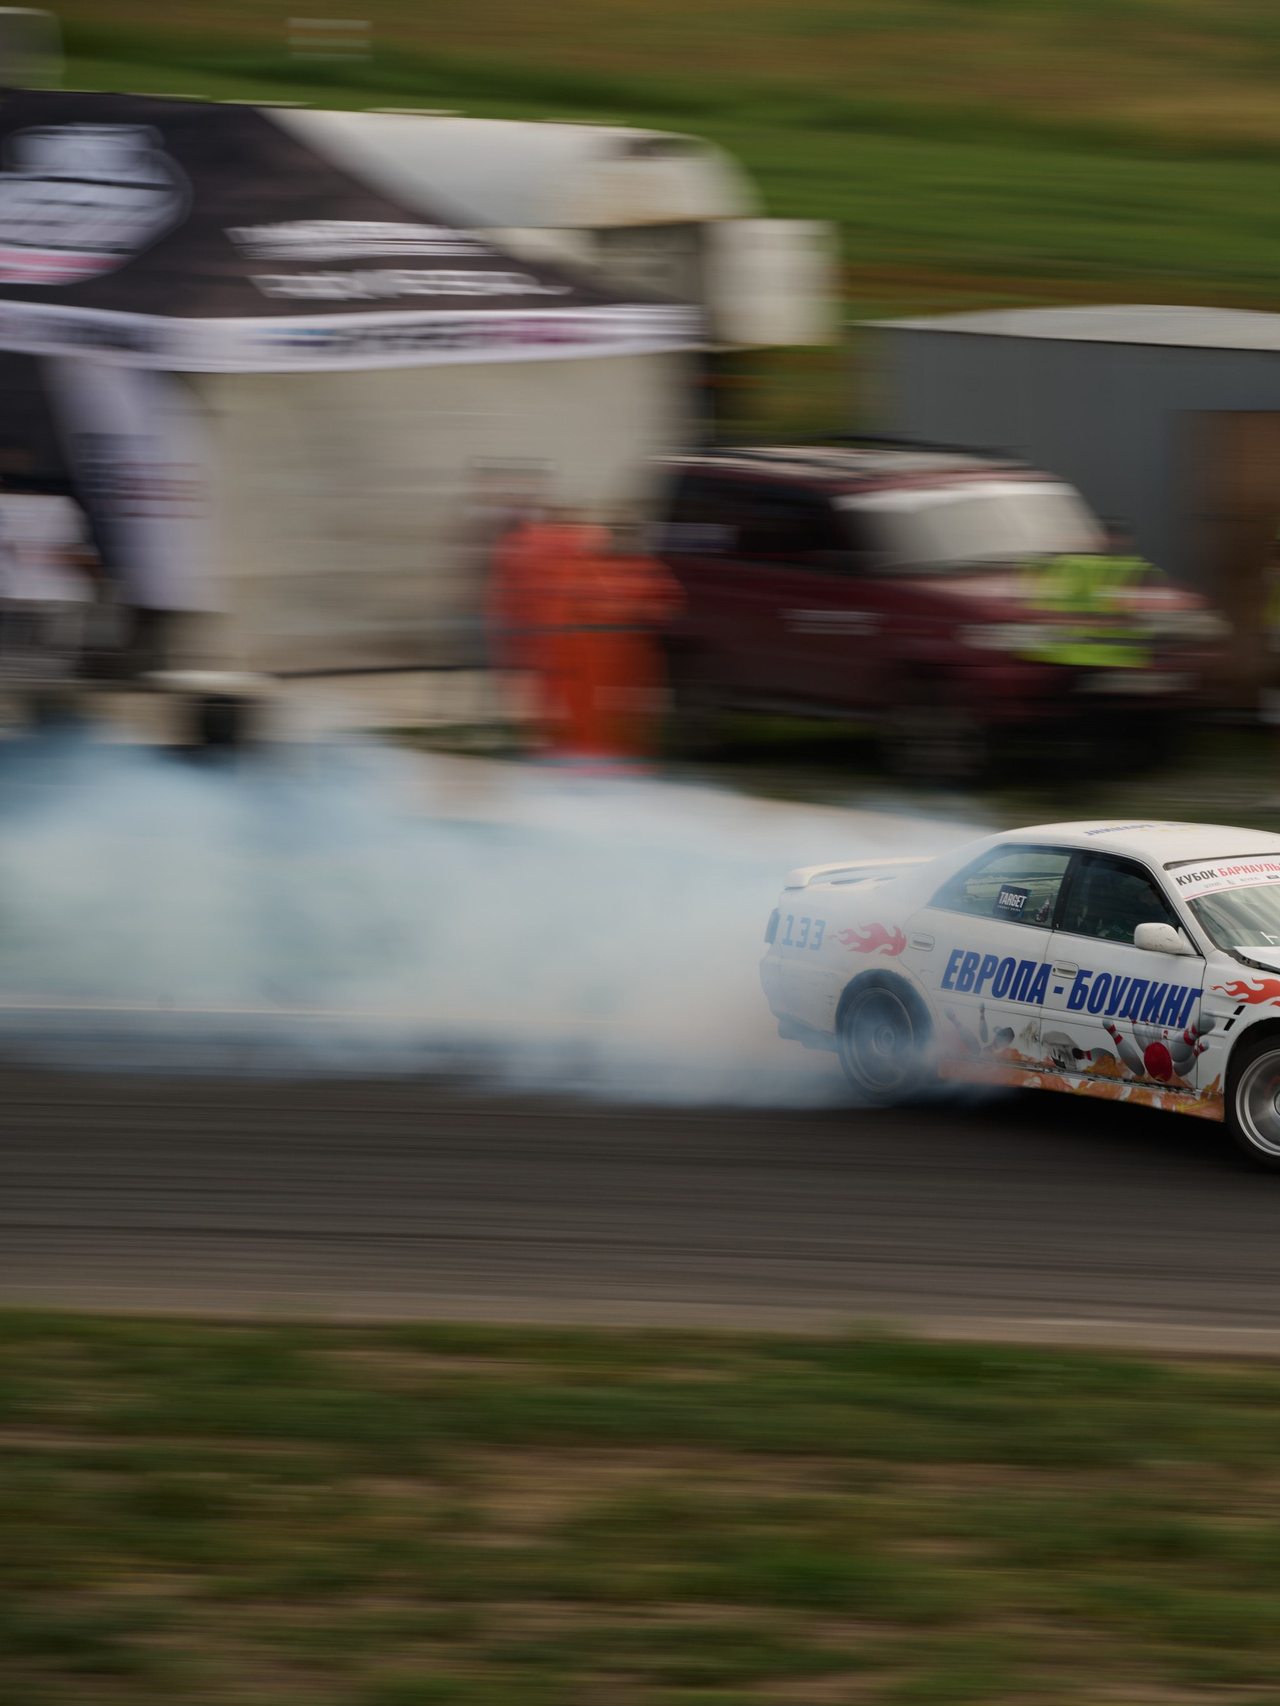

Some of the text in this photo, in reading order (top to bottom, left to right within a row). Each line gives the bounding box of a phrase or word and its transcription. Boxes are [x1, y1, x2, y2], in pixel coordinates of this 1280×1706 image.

[1175, 869, 1218, 886] КУБОК
[998, 891, 1027, 908] TARGET
[782, 914, 826, 950] 133
[941, 949, 1052, 1004] ЕВРОПА
[1066, 969, 1204, 1029] БОУЛИНГ
